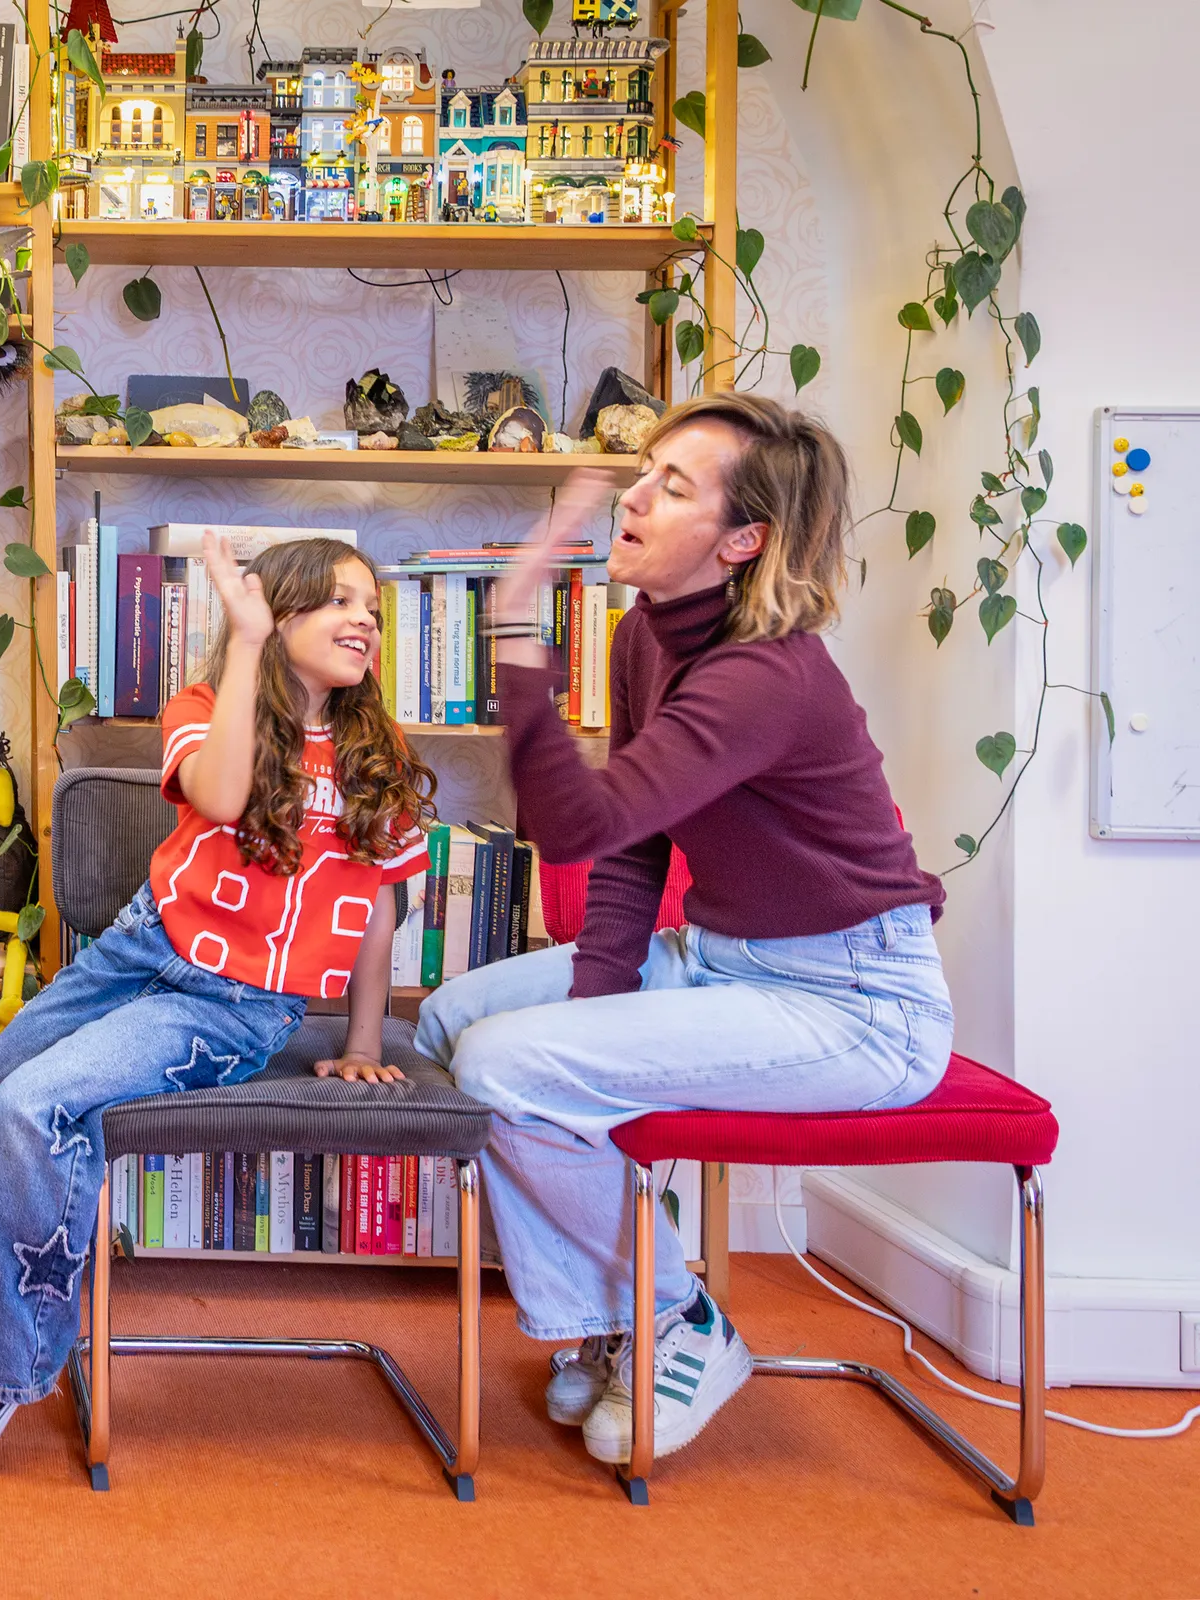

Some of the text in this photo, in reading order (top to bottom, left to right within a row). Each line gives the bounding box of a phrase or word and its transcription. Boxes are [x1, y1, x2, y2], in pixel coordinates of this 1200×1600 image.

[18, 85, 26, 96] DE
[403, 163, 423, 173] BOOKS
[133, 576, 142, 637] Psycho-educatie
[399, 588, 409, 629] SACKS
[409, 588, 419, 630] OLIVER
[169, 601, 179, 698] 1000 RECORD COVER
[404, 636, 413, 701] MUSICOFILIA
[452, 620, 462, 686] Terug naar normaal
[466, 653, 474, 682] waanzin
[572, 666, 580, 693] HOOFD
[305, 815, 336, 836] Tea
[510, 904, 521, 955] HEMINGWAY
[170, 1169, 183, 1220] Helden
[303, 1163, 313, 1214] Homo Deus
[360, 1171, 368, 1179] IK
[360, 1179, 368, 1193] HEB
[421, 1173, 431, 1213] Identiteit
[436, 1166, 446, 1185] DIS
[274, 1172, 290, 1225] Mythos
[359, 1194, 368, 1207] EEN
[376, 1166, 384, 1236] TIKKOP
[359, 1208, 368, 1233] PUBER!
